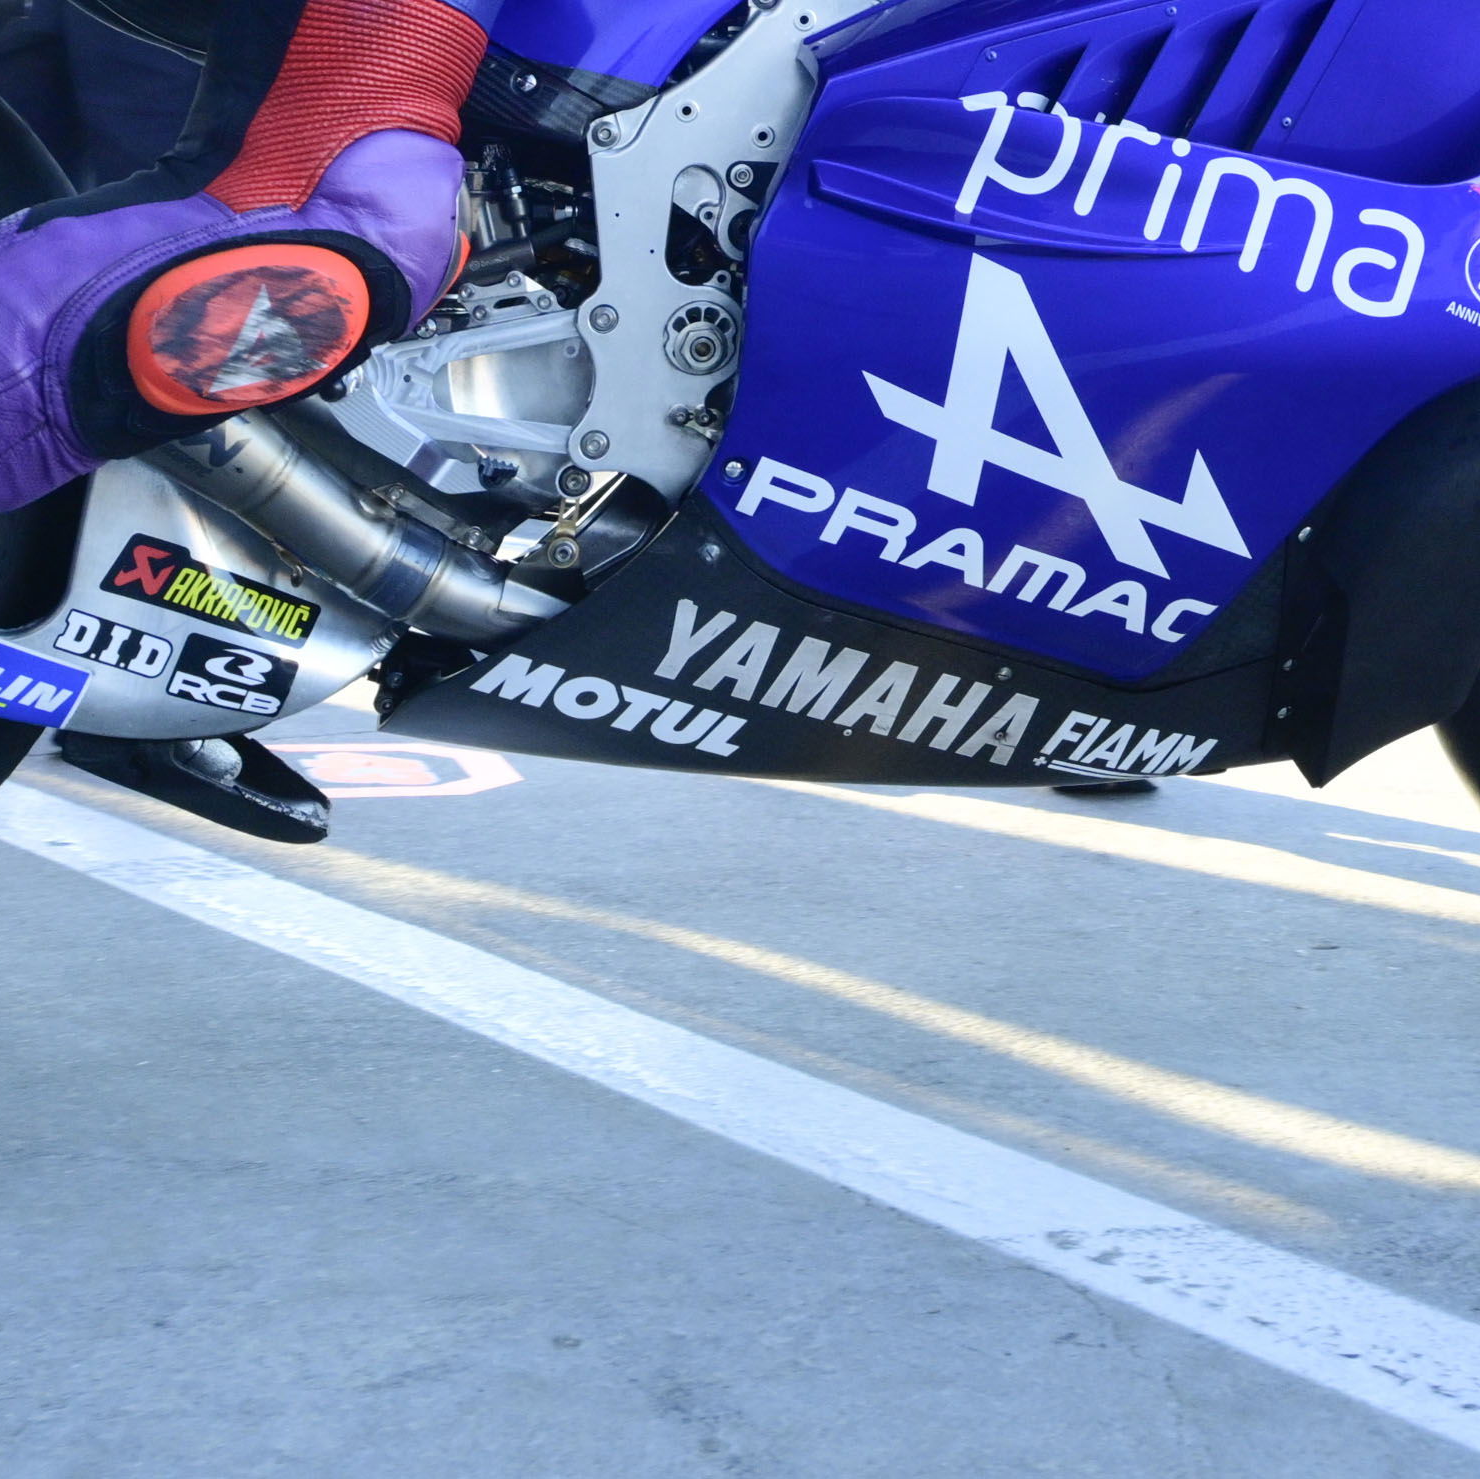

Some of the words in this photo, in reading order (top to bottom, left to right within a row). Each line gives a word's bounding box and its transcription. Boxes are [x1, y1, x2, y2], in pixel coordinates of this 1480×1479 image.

[954, 91, 1426, 319] prima
[735, 455, 1221, 644] PRAMAC
[53, 616, 174, 677] D.I.D
[167, 670, 282, 716] RCB
[652, 598, 1042, 767] YAMAHA
[469, 653, 751, 758] MOTUL
[1040, 710, 1219, 776] FIAMM
